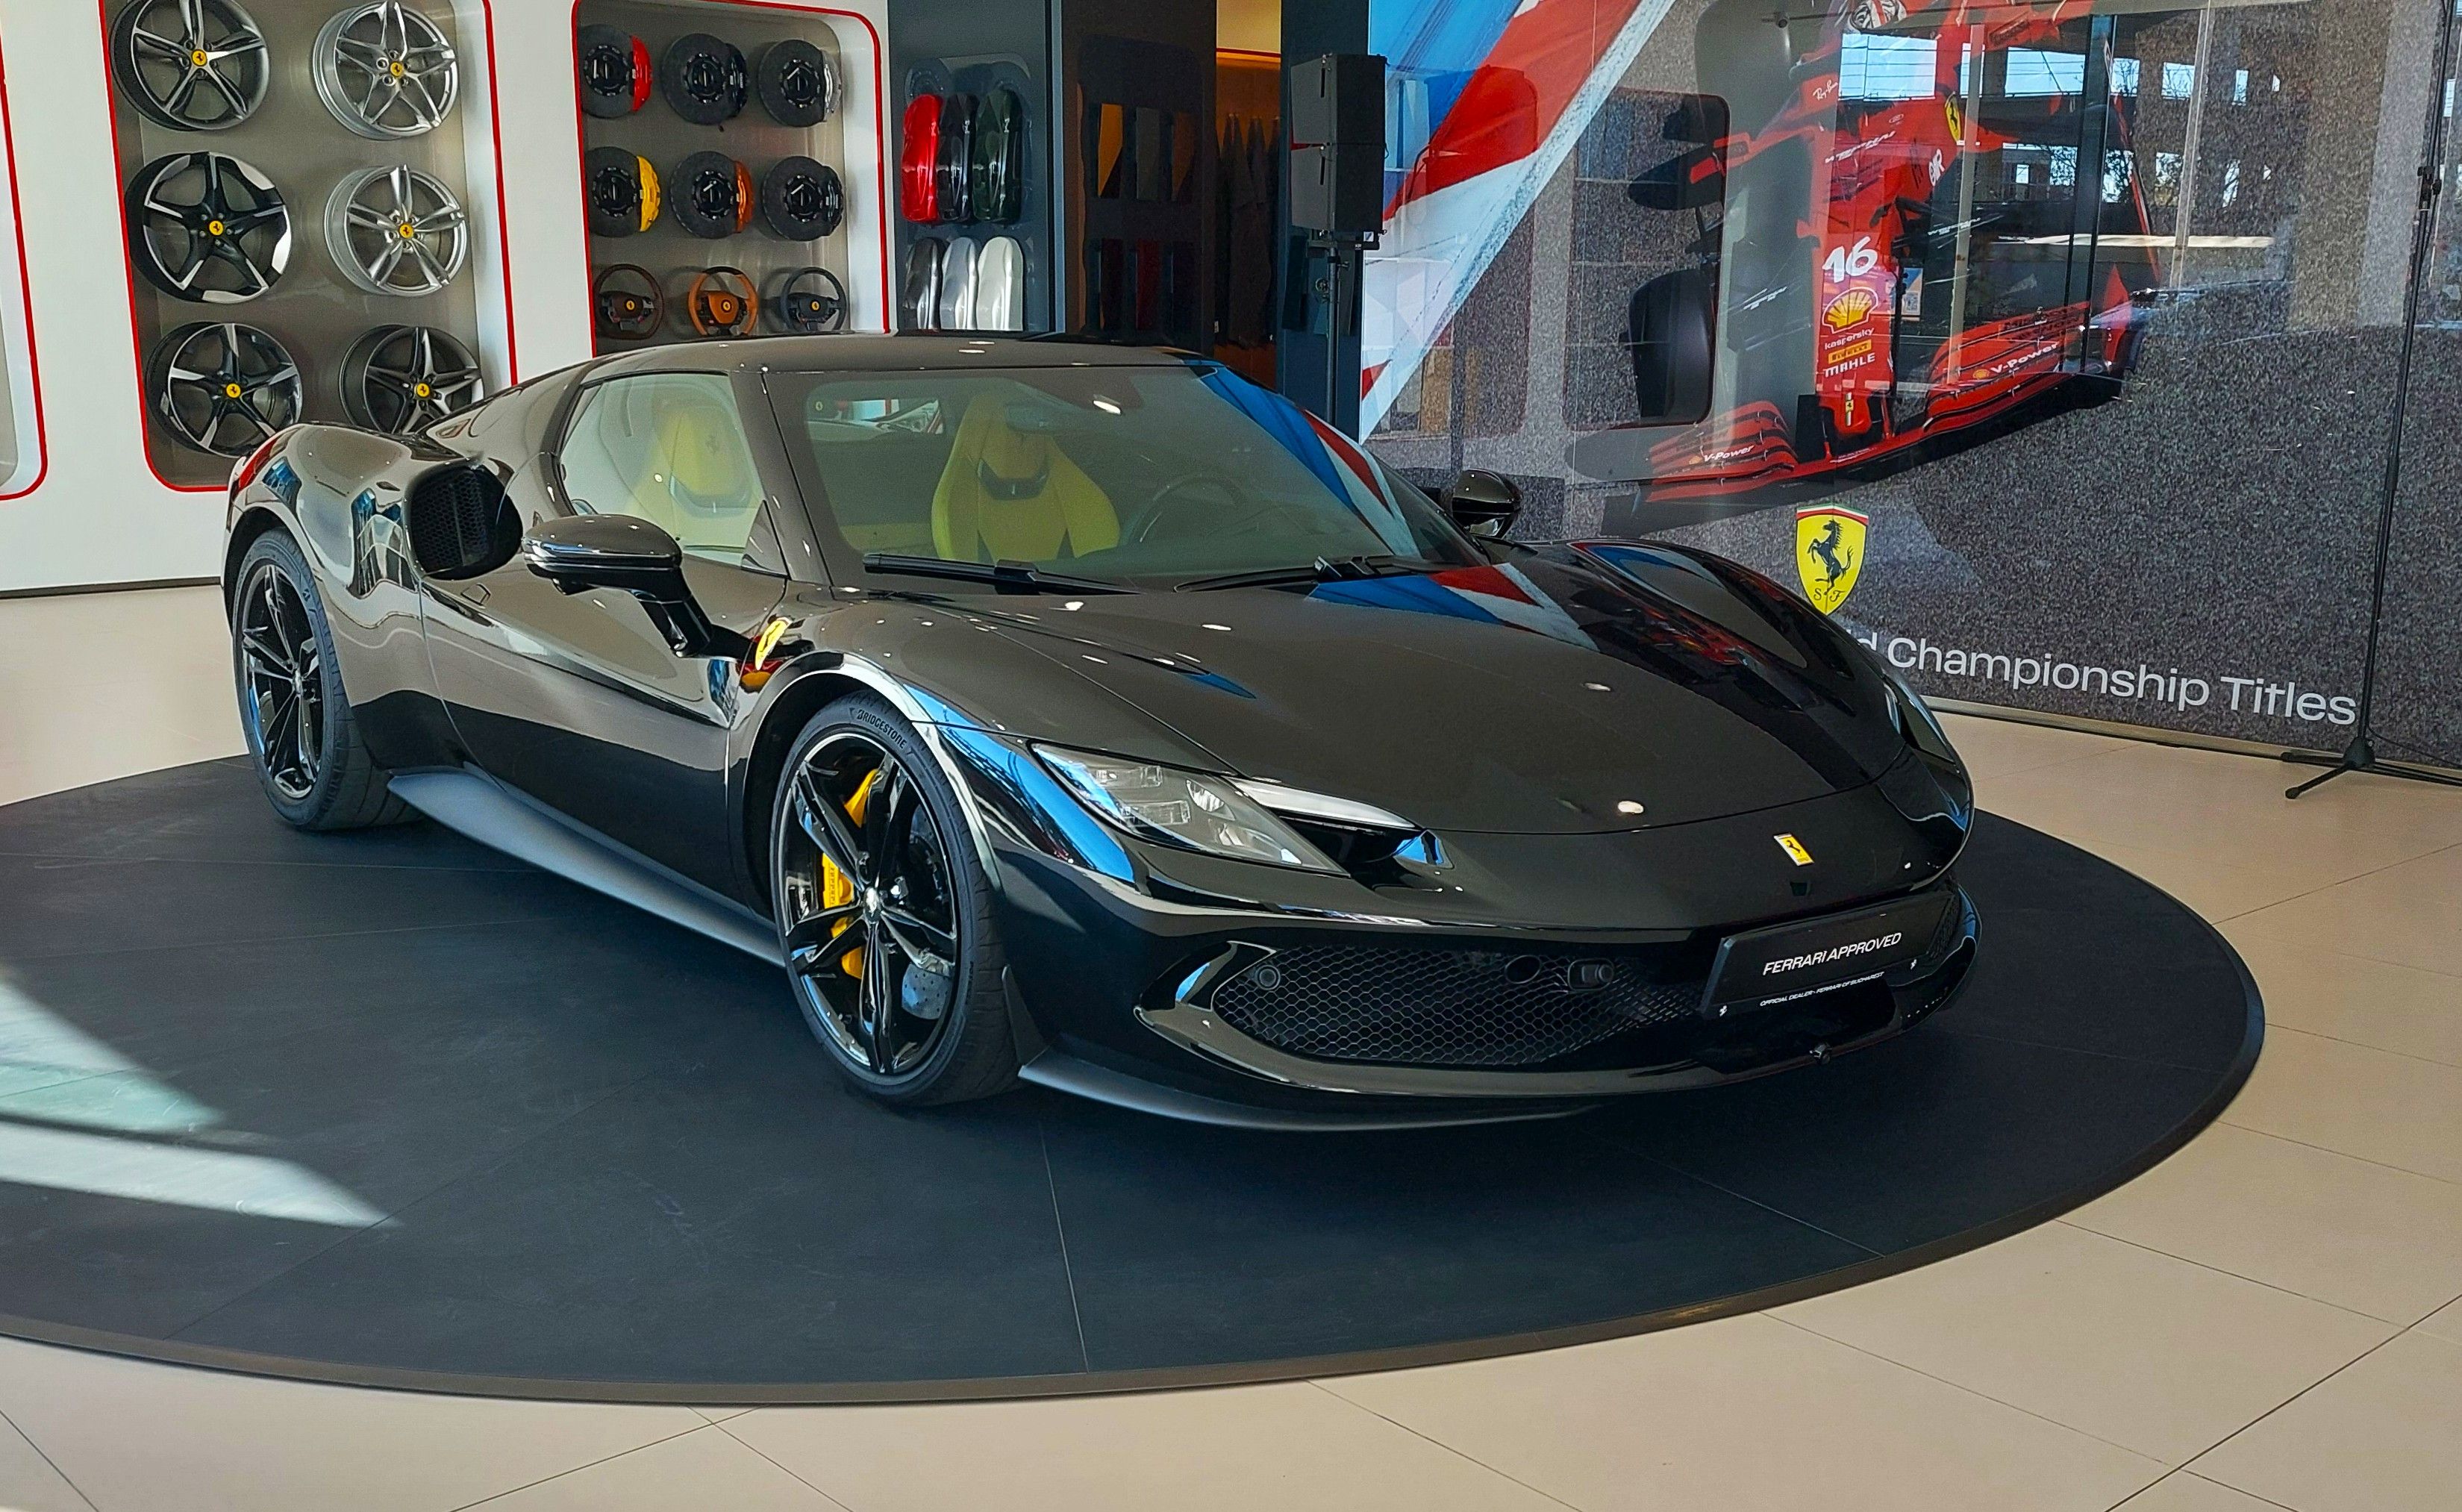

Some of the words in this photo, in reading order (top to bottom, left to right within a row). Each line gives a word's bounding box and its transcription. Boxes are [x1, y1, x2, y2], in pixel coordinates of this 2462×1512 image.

[1822, 236, 1878, 283] 16
[1825, 328, 1875, 350] kaspersky
[1825, 352, 1875, 378] MAHLE
[1990, 342, 2059, 374] V-Power
[1703, 445, 1755, 463] V-Power
[1813, 587, 1822, 601] S
[1829, 589, 1846, 603] F
[1887, 637, 2210, 712] Championship
[2220, 676, 2357, 725] Titles
[857, 709, 907, 749] BRIDGESTONE
[1763, 950, 1828, 976] FERRARI
[1826, 932, 1902, 962] APPROVED
